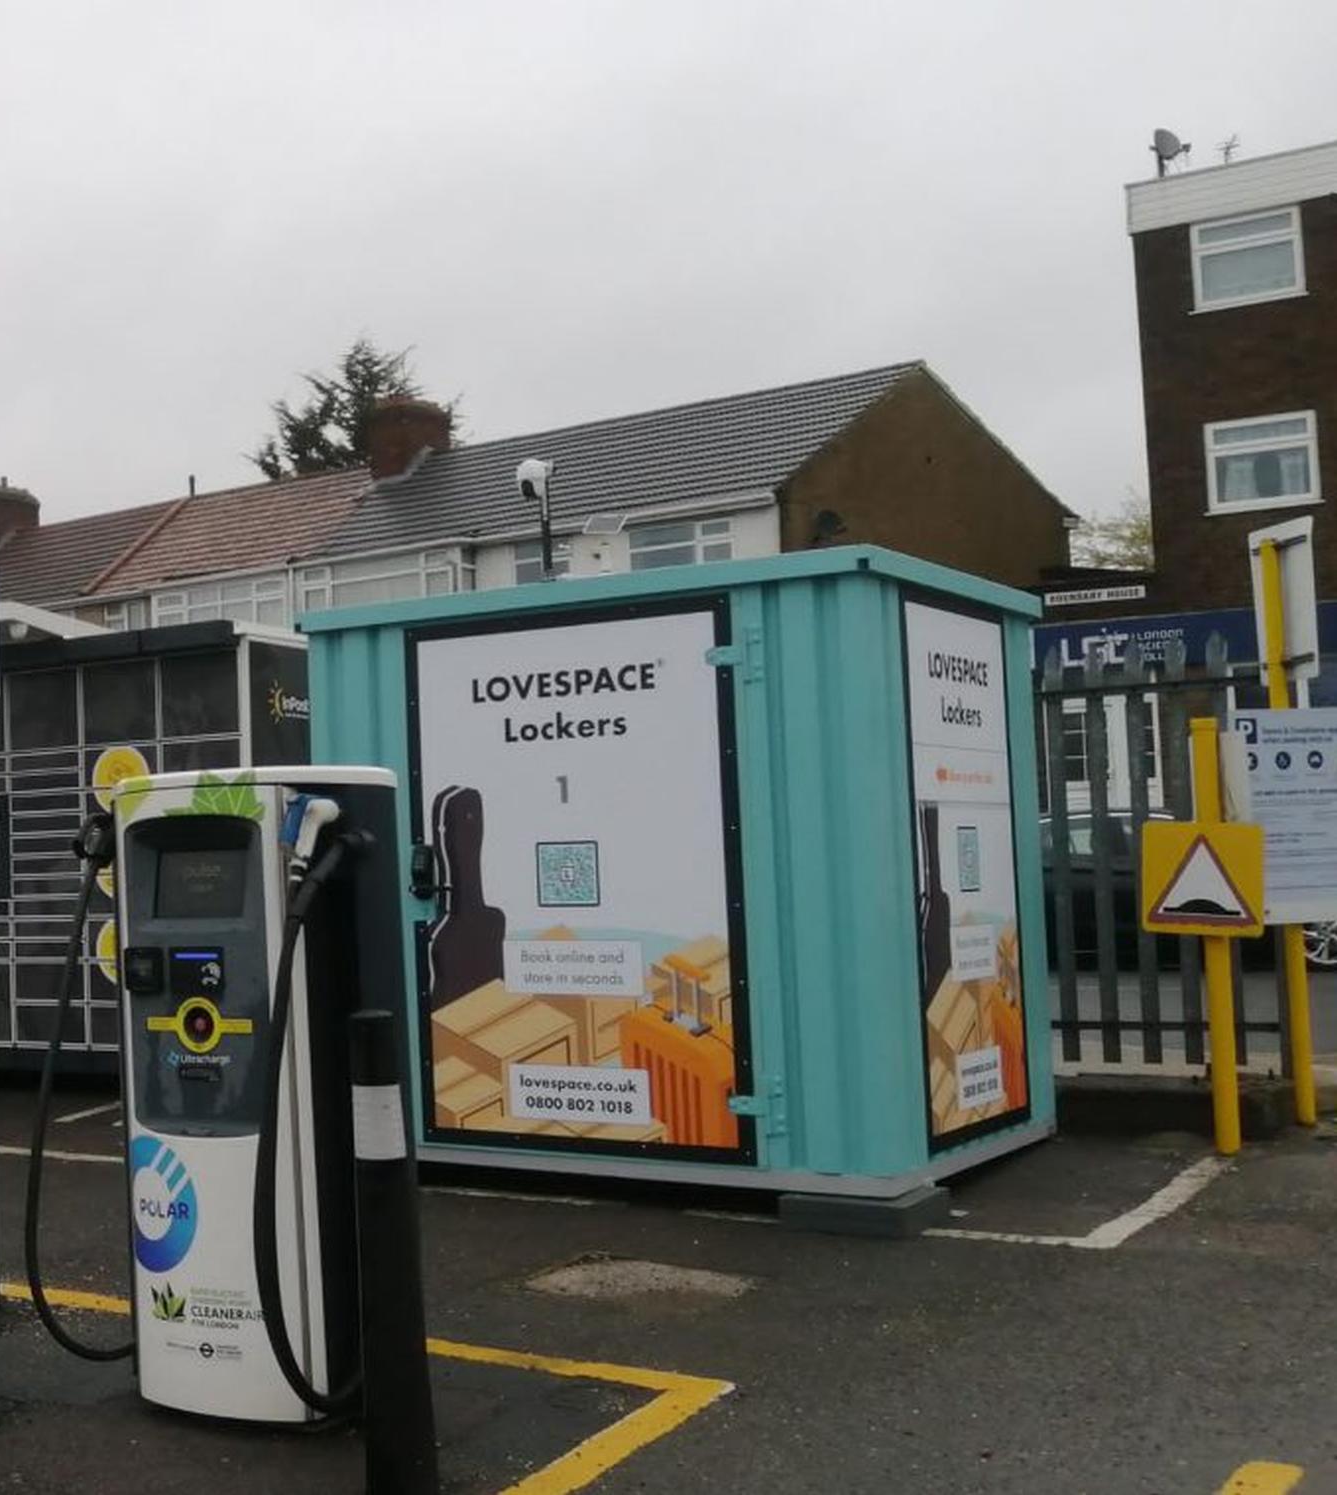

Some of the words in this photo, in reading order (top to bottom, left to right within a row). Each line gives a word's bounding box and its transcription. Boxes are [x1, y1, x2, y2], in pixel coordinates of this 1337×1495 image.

[928, 651, 988, 687] LOVESPACE
[472, 662, 656, 703] LOVESPACE
[941, 697, 982, 728] Lockers
[504, 712, 628, 743] Lockers
[555, 776, 570, 804] 1
[520, 950, 553, 963] Book
[555, 950, 594, 963] online
[598, 950, 624, 964] and
[524, 972, 553, 984] store
[556, 972, 568, 983] in
[572, 971, 624, 985] seconds
[519, 1074, 637, 1093] lovespace.co.uk
[526, 1096, 563, 1110] 0800
[567, 1098, 595, 1112] 802
[600, 1100, 633, 1114] 1018
[139, 1200, 190, 1220] POLAR
